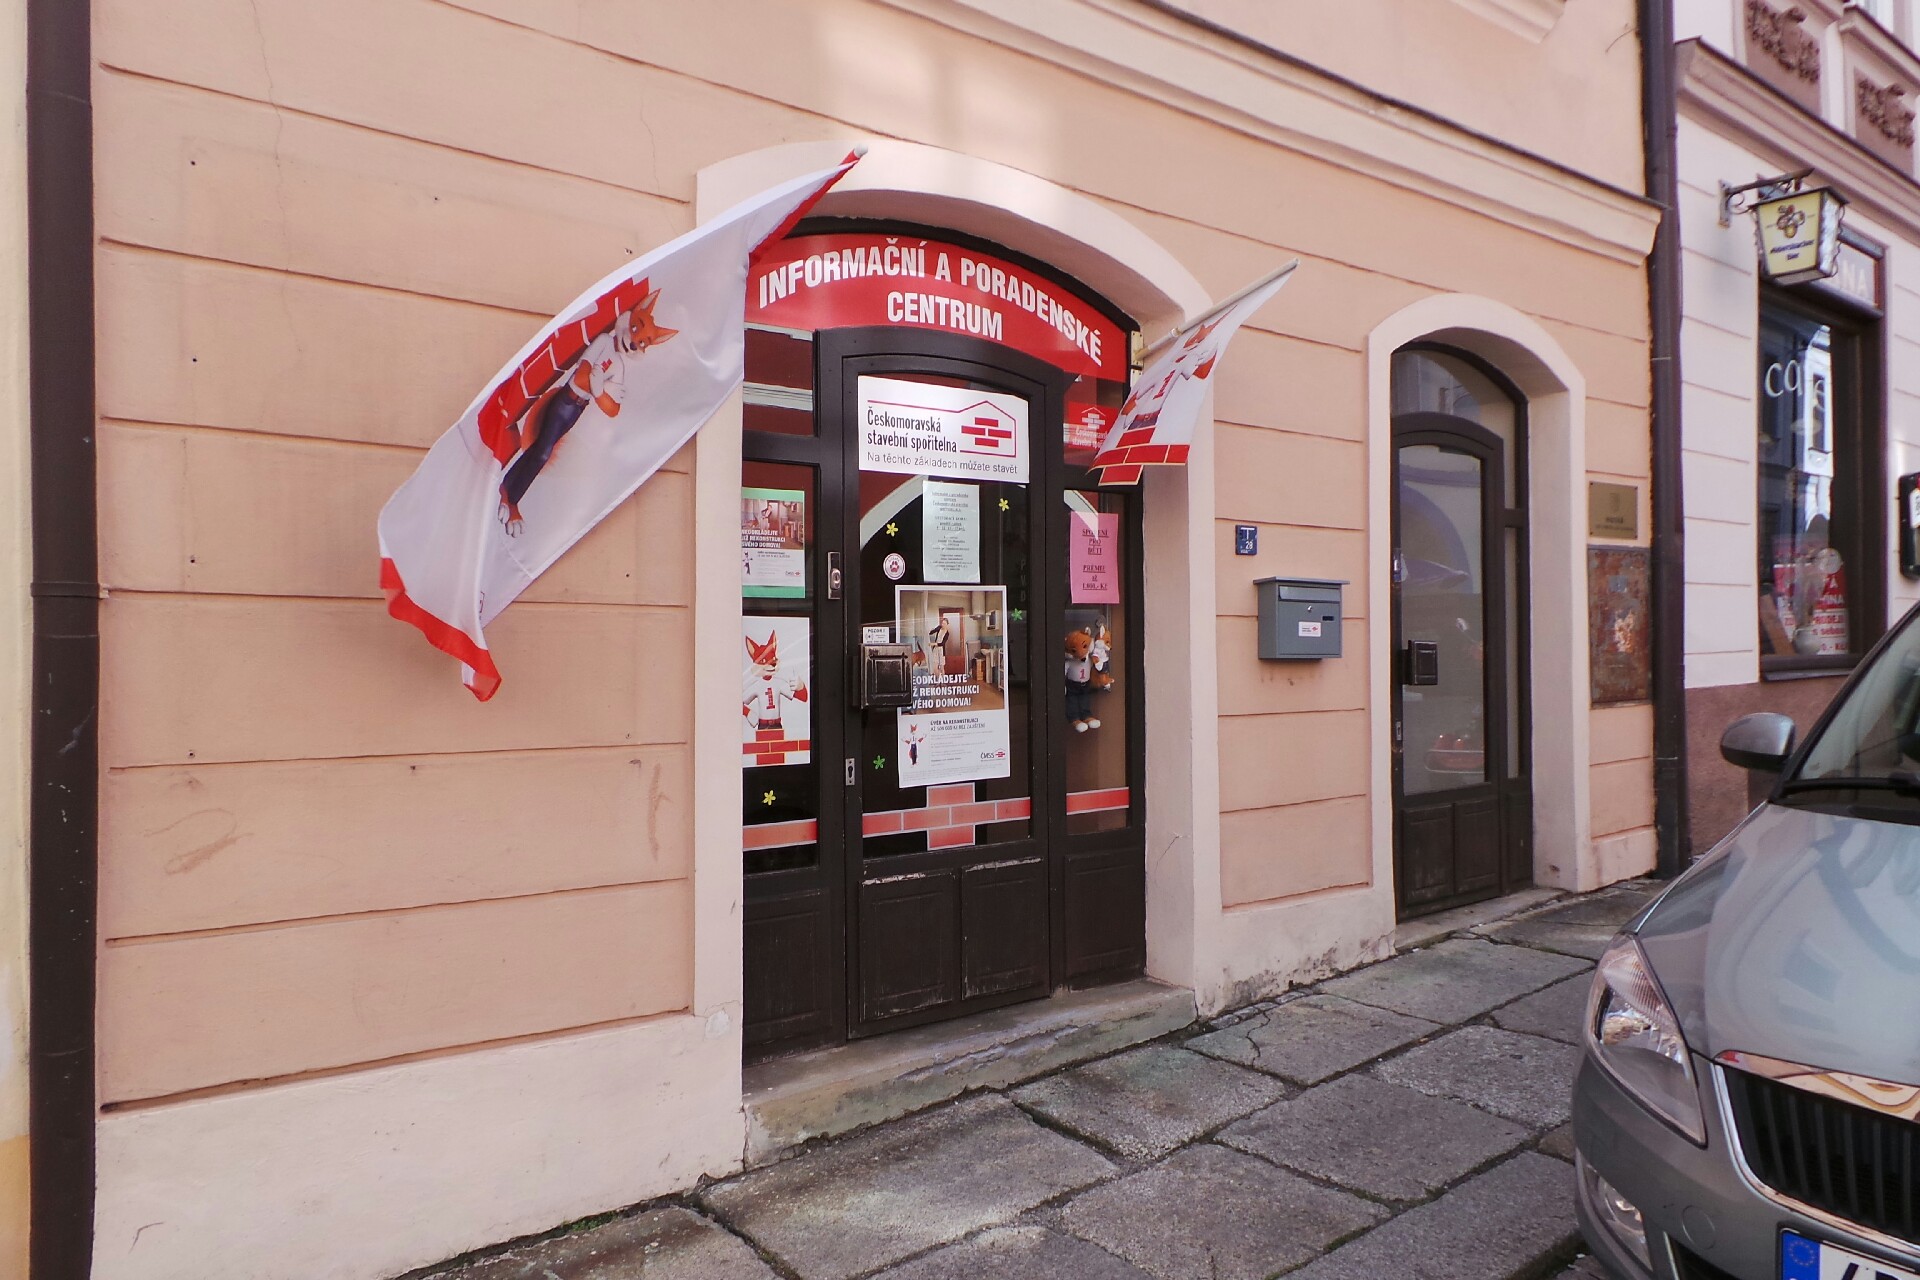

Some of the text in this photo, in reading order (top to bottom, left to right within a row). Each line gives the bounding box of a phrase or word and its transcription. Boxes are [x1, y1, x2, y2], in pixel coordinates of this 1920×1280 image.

[760, 238, 1104, 367] INFORMAČNÍ A PORADENSKÉ
[888, 291, 1003, 341] CENTRUM
[867, 406, 941, 433] Českomoravská
[867, 430, 957, 454] stavební spořitelna
[867, 452, 1018, 475] Na těchto základech můžete stavět
[912, 674, 968, 686] EODKLÁDEJTE
[919, 685, 979, 697] REKONSTRUKCI
[907, 697, 971, 709] VÉHO DOMOVA!
